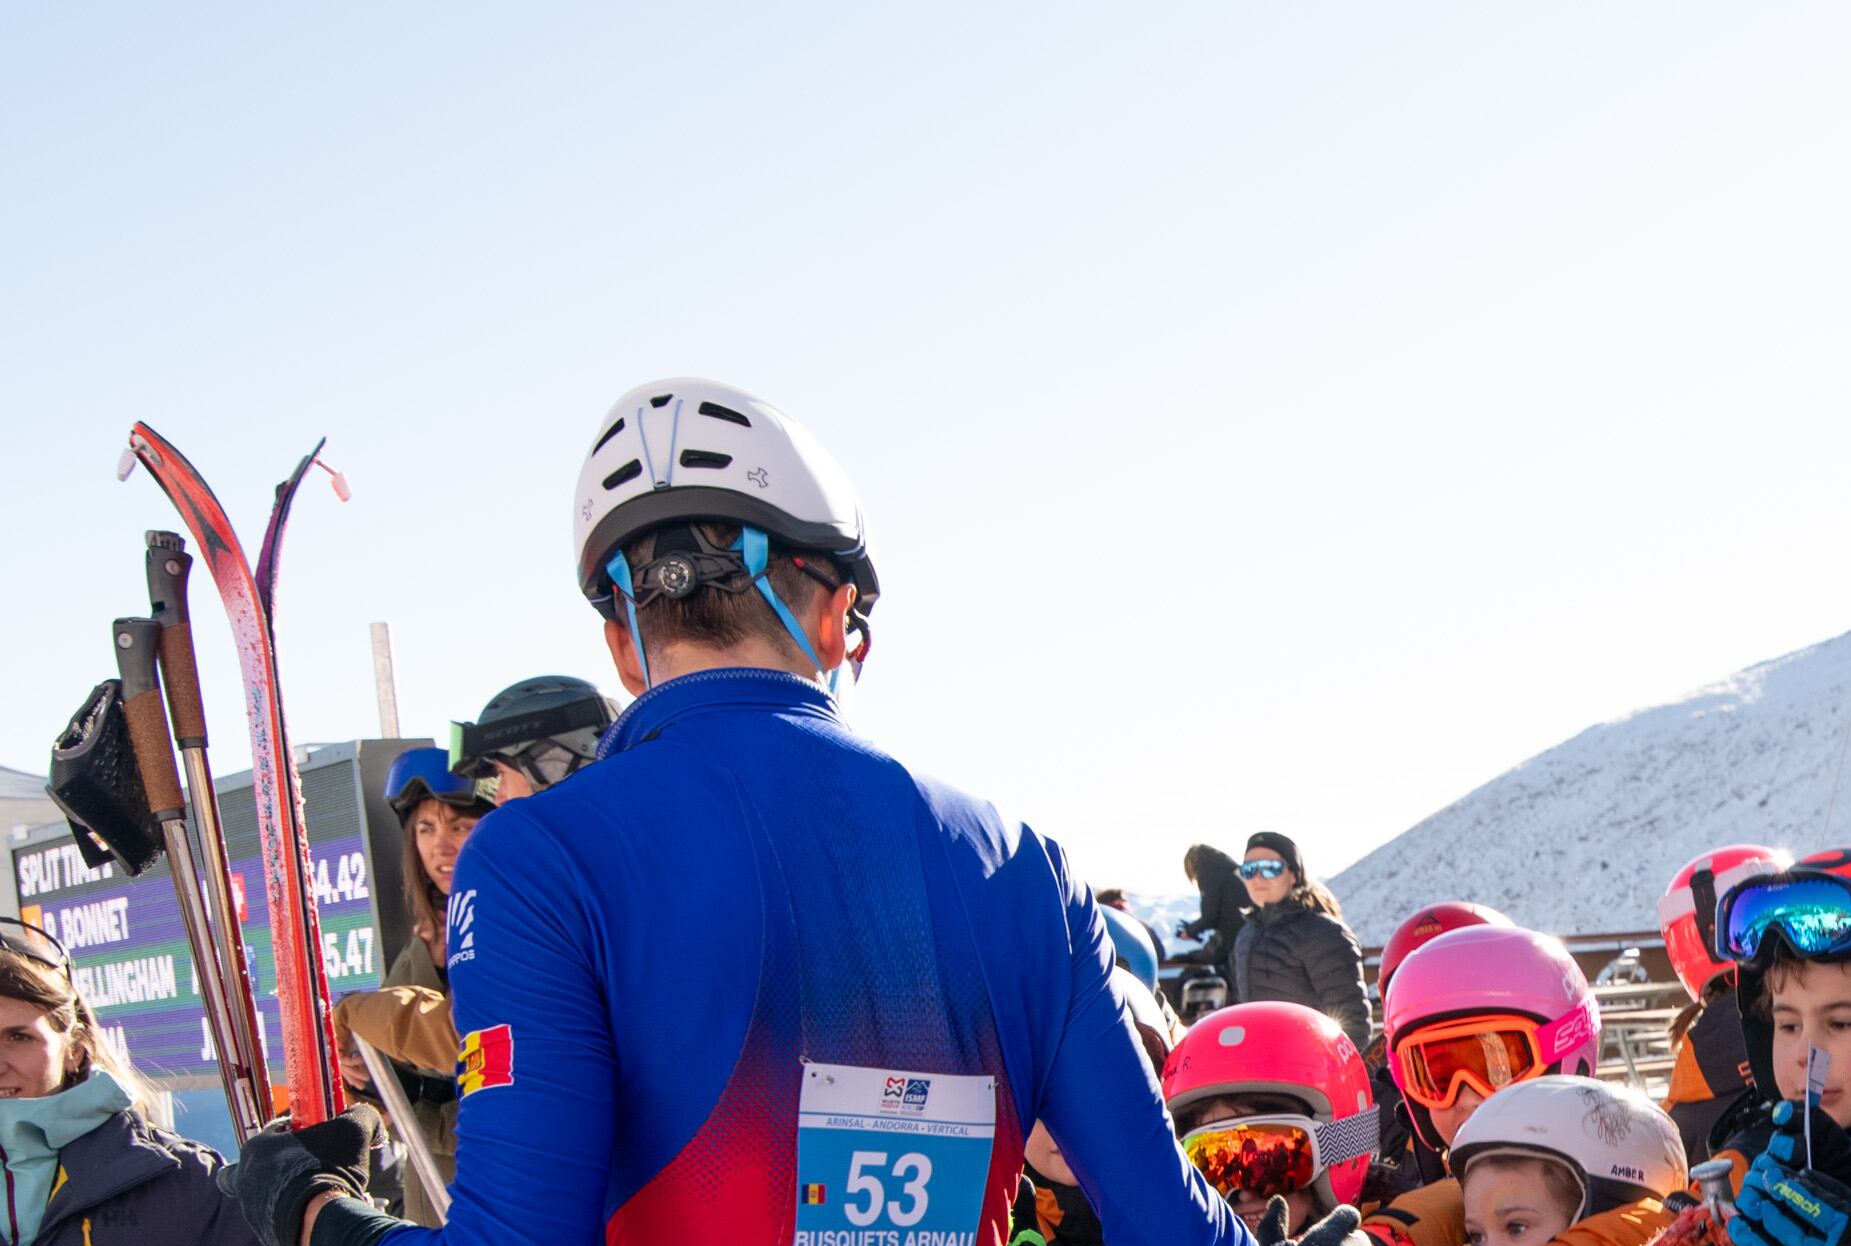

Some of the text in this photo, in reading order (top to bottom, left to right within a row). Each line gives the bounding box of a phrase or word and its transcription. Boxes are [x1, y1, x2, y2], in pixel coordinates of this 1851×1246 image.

[19, 848, 60, 897] SPLIT
[60, 897, 130, 950] BONNET
[826, 1117, 969, 1136] ARINSAL ANDORRA VERTICAL
[843, 1150, 934, 1227] 53
[1610, 1163, 1644, 1182] AMBER
